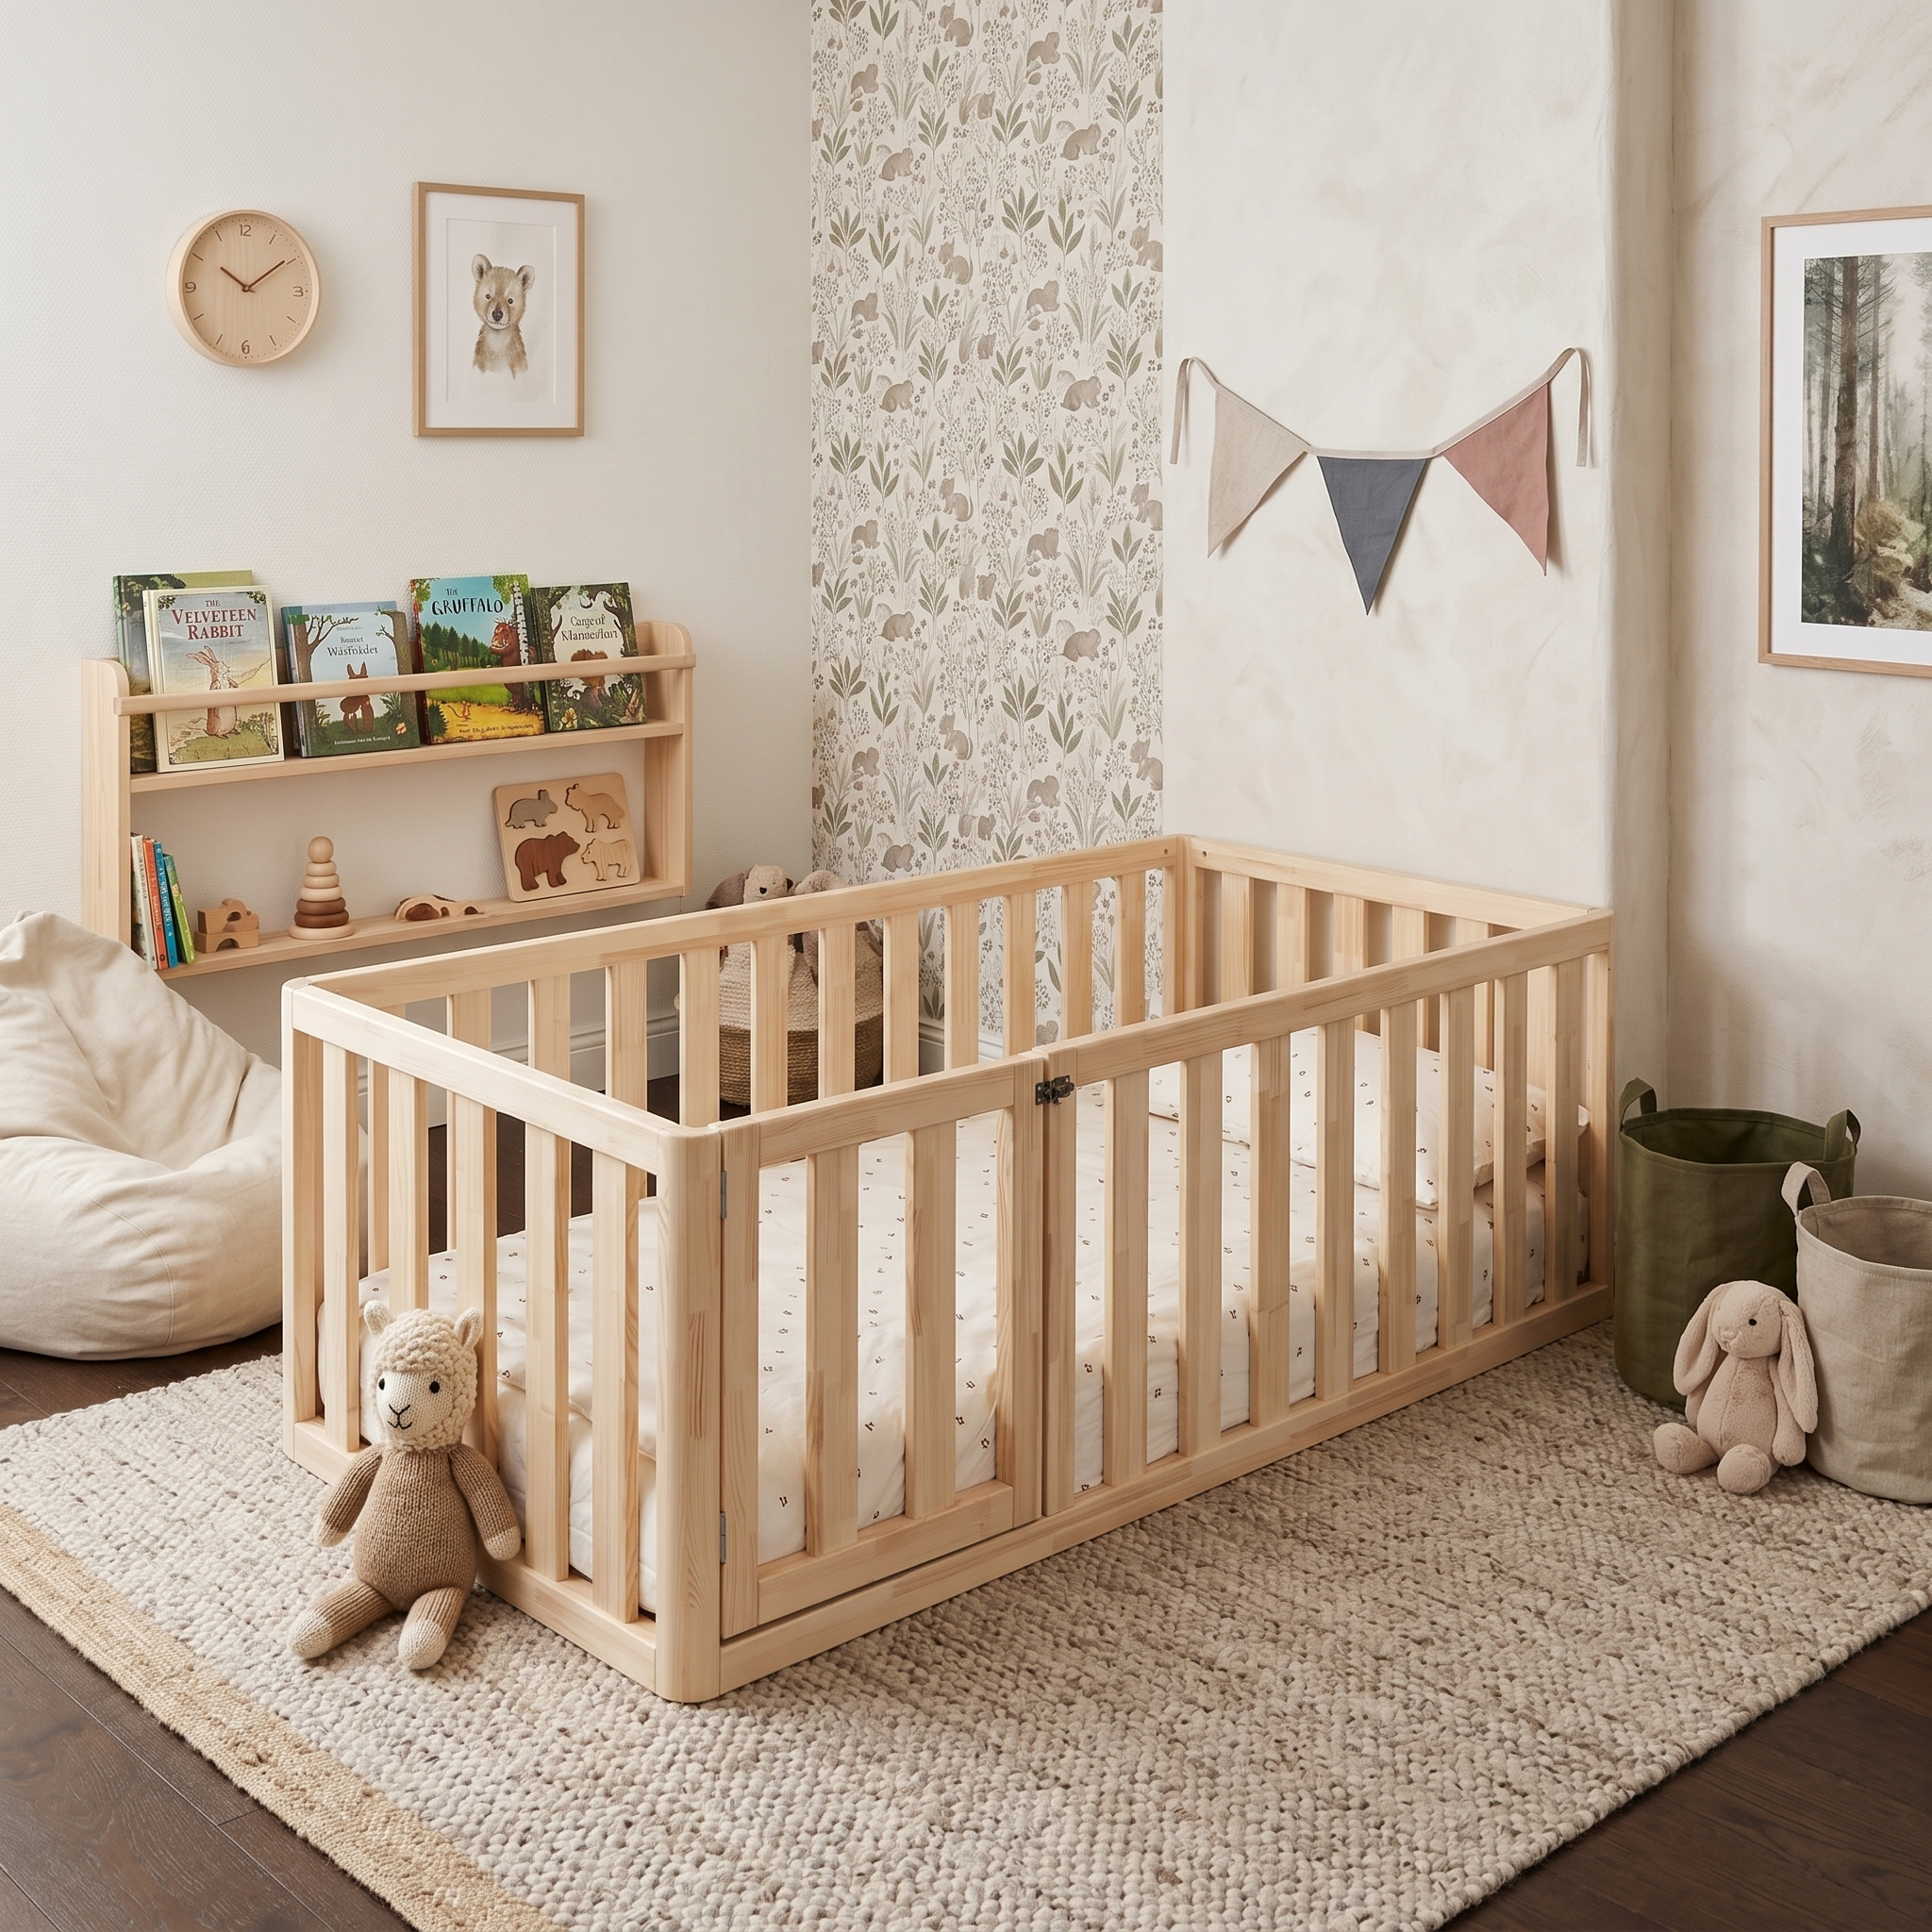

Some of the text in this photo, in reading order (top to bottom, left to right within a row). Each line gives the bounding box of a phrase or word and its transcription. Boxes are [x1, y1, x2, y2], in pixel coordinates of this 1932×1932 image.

[240, 224, 252, 237] 12
[185, 281, 197, 293] 9
[292, 285, 304, 297] 3
[241, 340, 251, 355] 6
[445, 588, 458, 596] THE
[205, 599, 221, 608] THE
[431, 597, 504, 616] GRUFFALO
[171, 608, 257, 625] VELVETEEN
[187, 625, 244, 641] RABBIT
